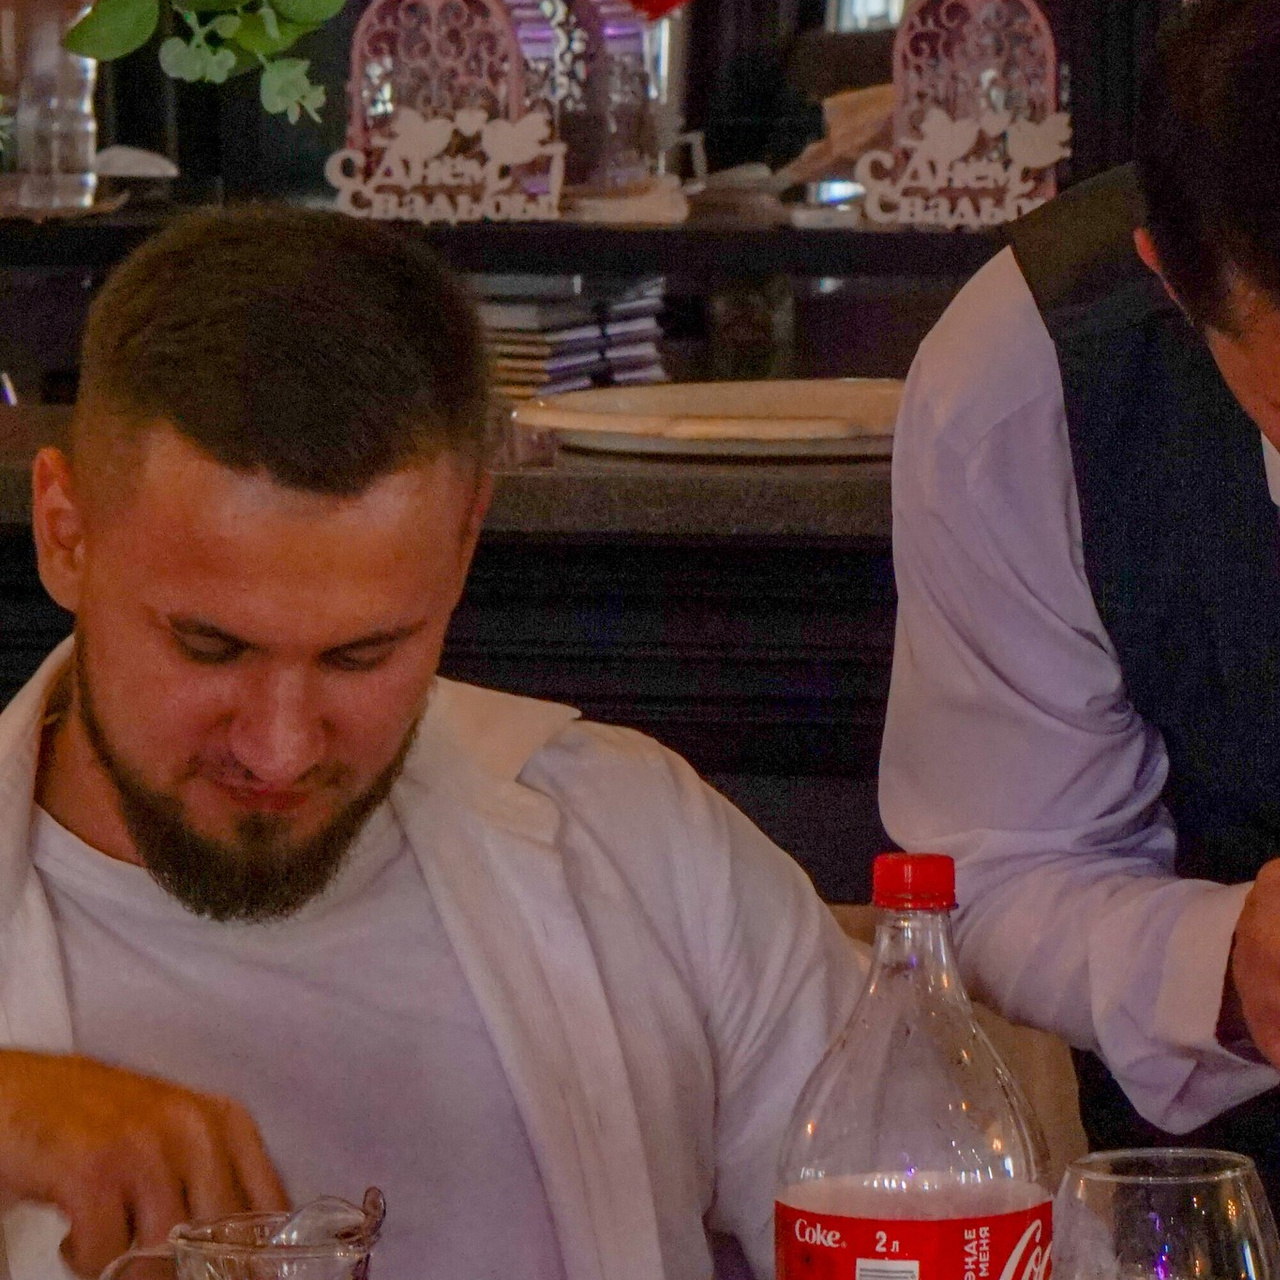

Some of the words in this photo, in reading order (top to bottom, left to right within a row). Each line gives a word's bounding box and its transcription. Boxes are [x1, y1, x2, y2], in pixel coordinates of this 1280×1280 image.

[794, 1218, 841, 1248] Coke
[875, 1230, 888, 1253] 2
[978, 1226, 990, 1278] МЕНЯ
